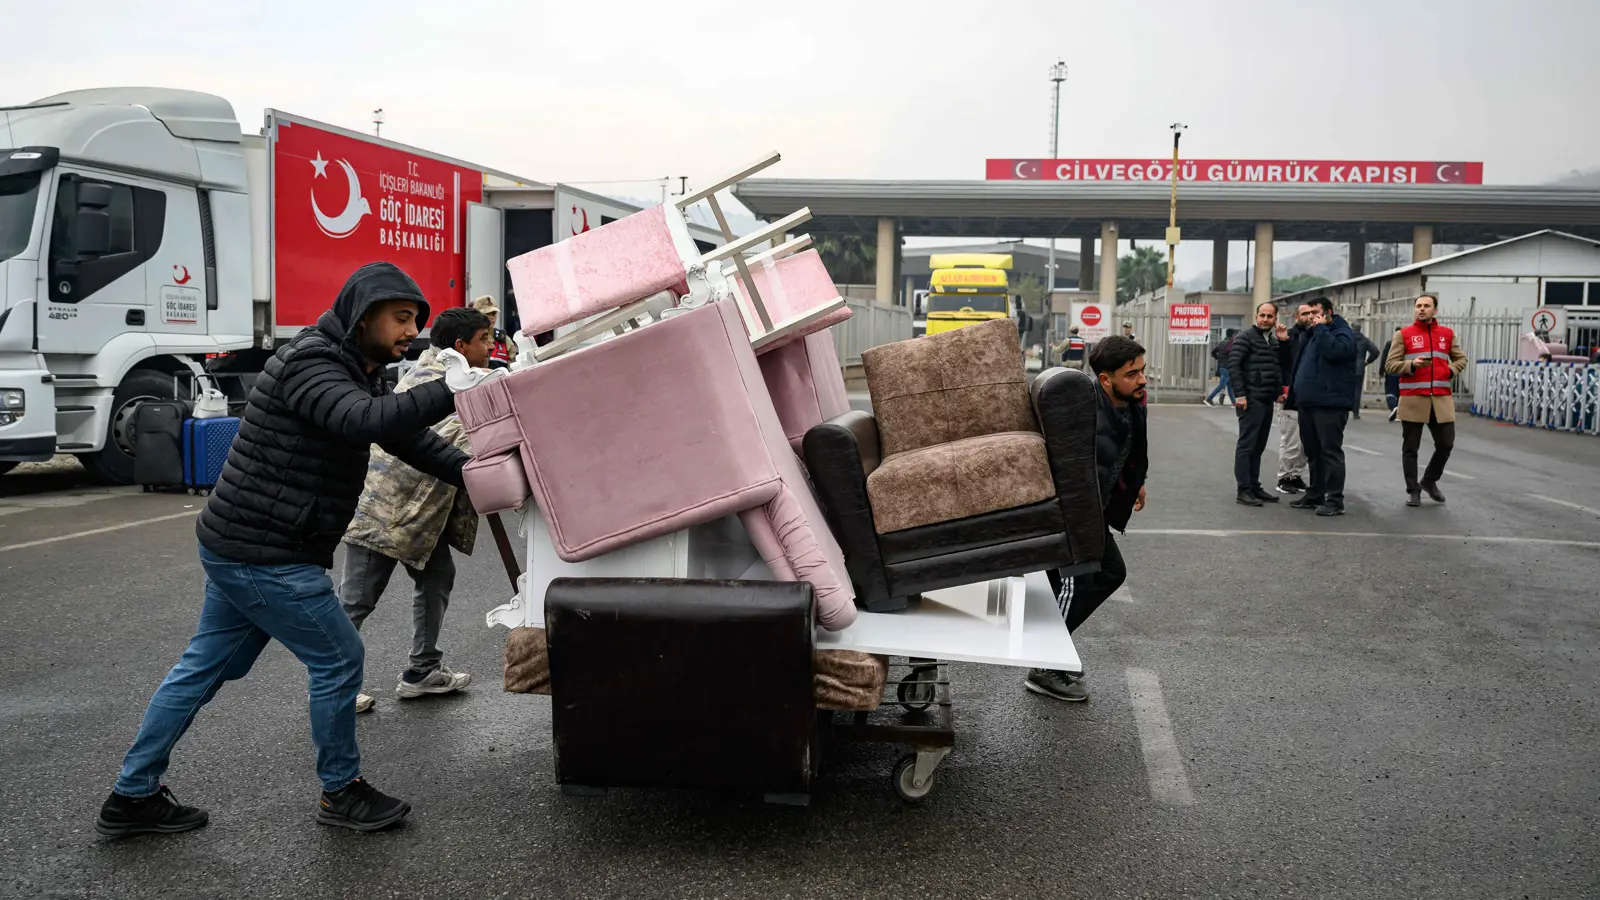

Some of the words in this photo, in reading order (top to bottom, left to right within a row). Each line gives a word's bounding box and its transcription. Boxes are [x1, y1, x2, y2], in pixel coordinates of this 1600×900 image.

[408, 160, 420, 178] T.C.
[1056, 160, 1197, 181] CİLVEGÖZÜ
[1207, 160, 1319, 182] GÜMRÜK
[1330, 165, 1417, 184] KAPISI
[380, 170, 408, 194] İÇİŞLERİ
[410, 180, 444, 200] BAKANLIĞI
[380, 195, 401, 229] GÖÇ
[405, 198, 444, 231] İDARESİ
[380, 228, 444, 252] BAŞKANLIĞI
[166, 301, 177, 311] GÖÇ
[178, 302, 197, 311] İDARESİ
[1174, 306, 1206, 316] PROTOKOL
[49, 312, 69, 320] 420
[1171, 317, 1188, 328] ARAÇ
[1189, 316, 1208, 328] GİRİŞİ
